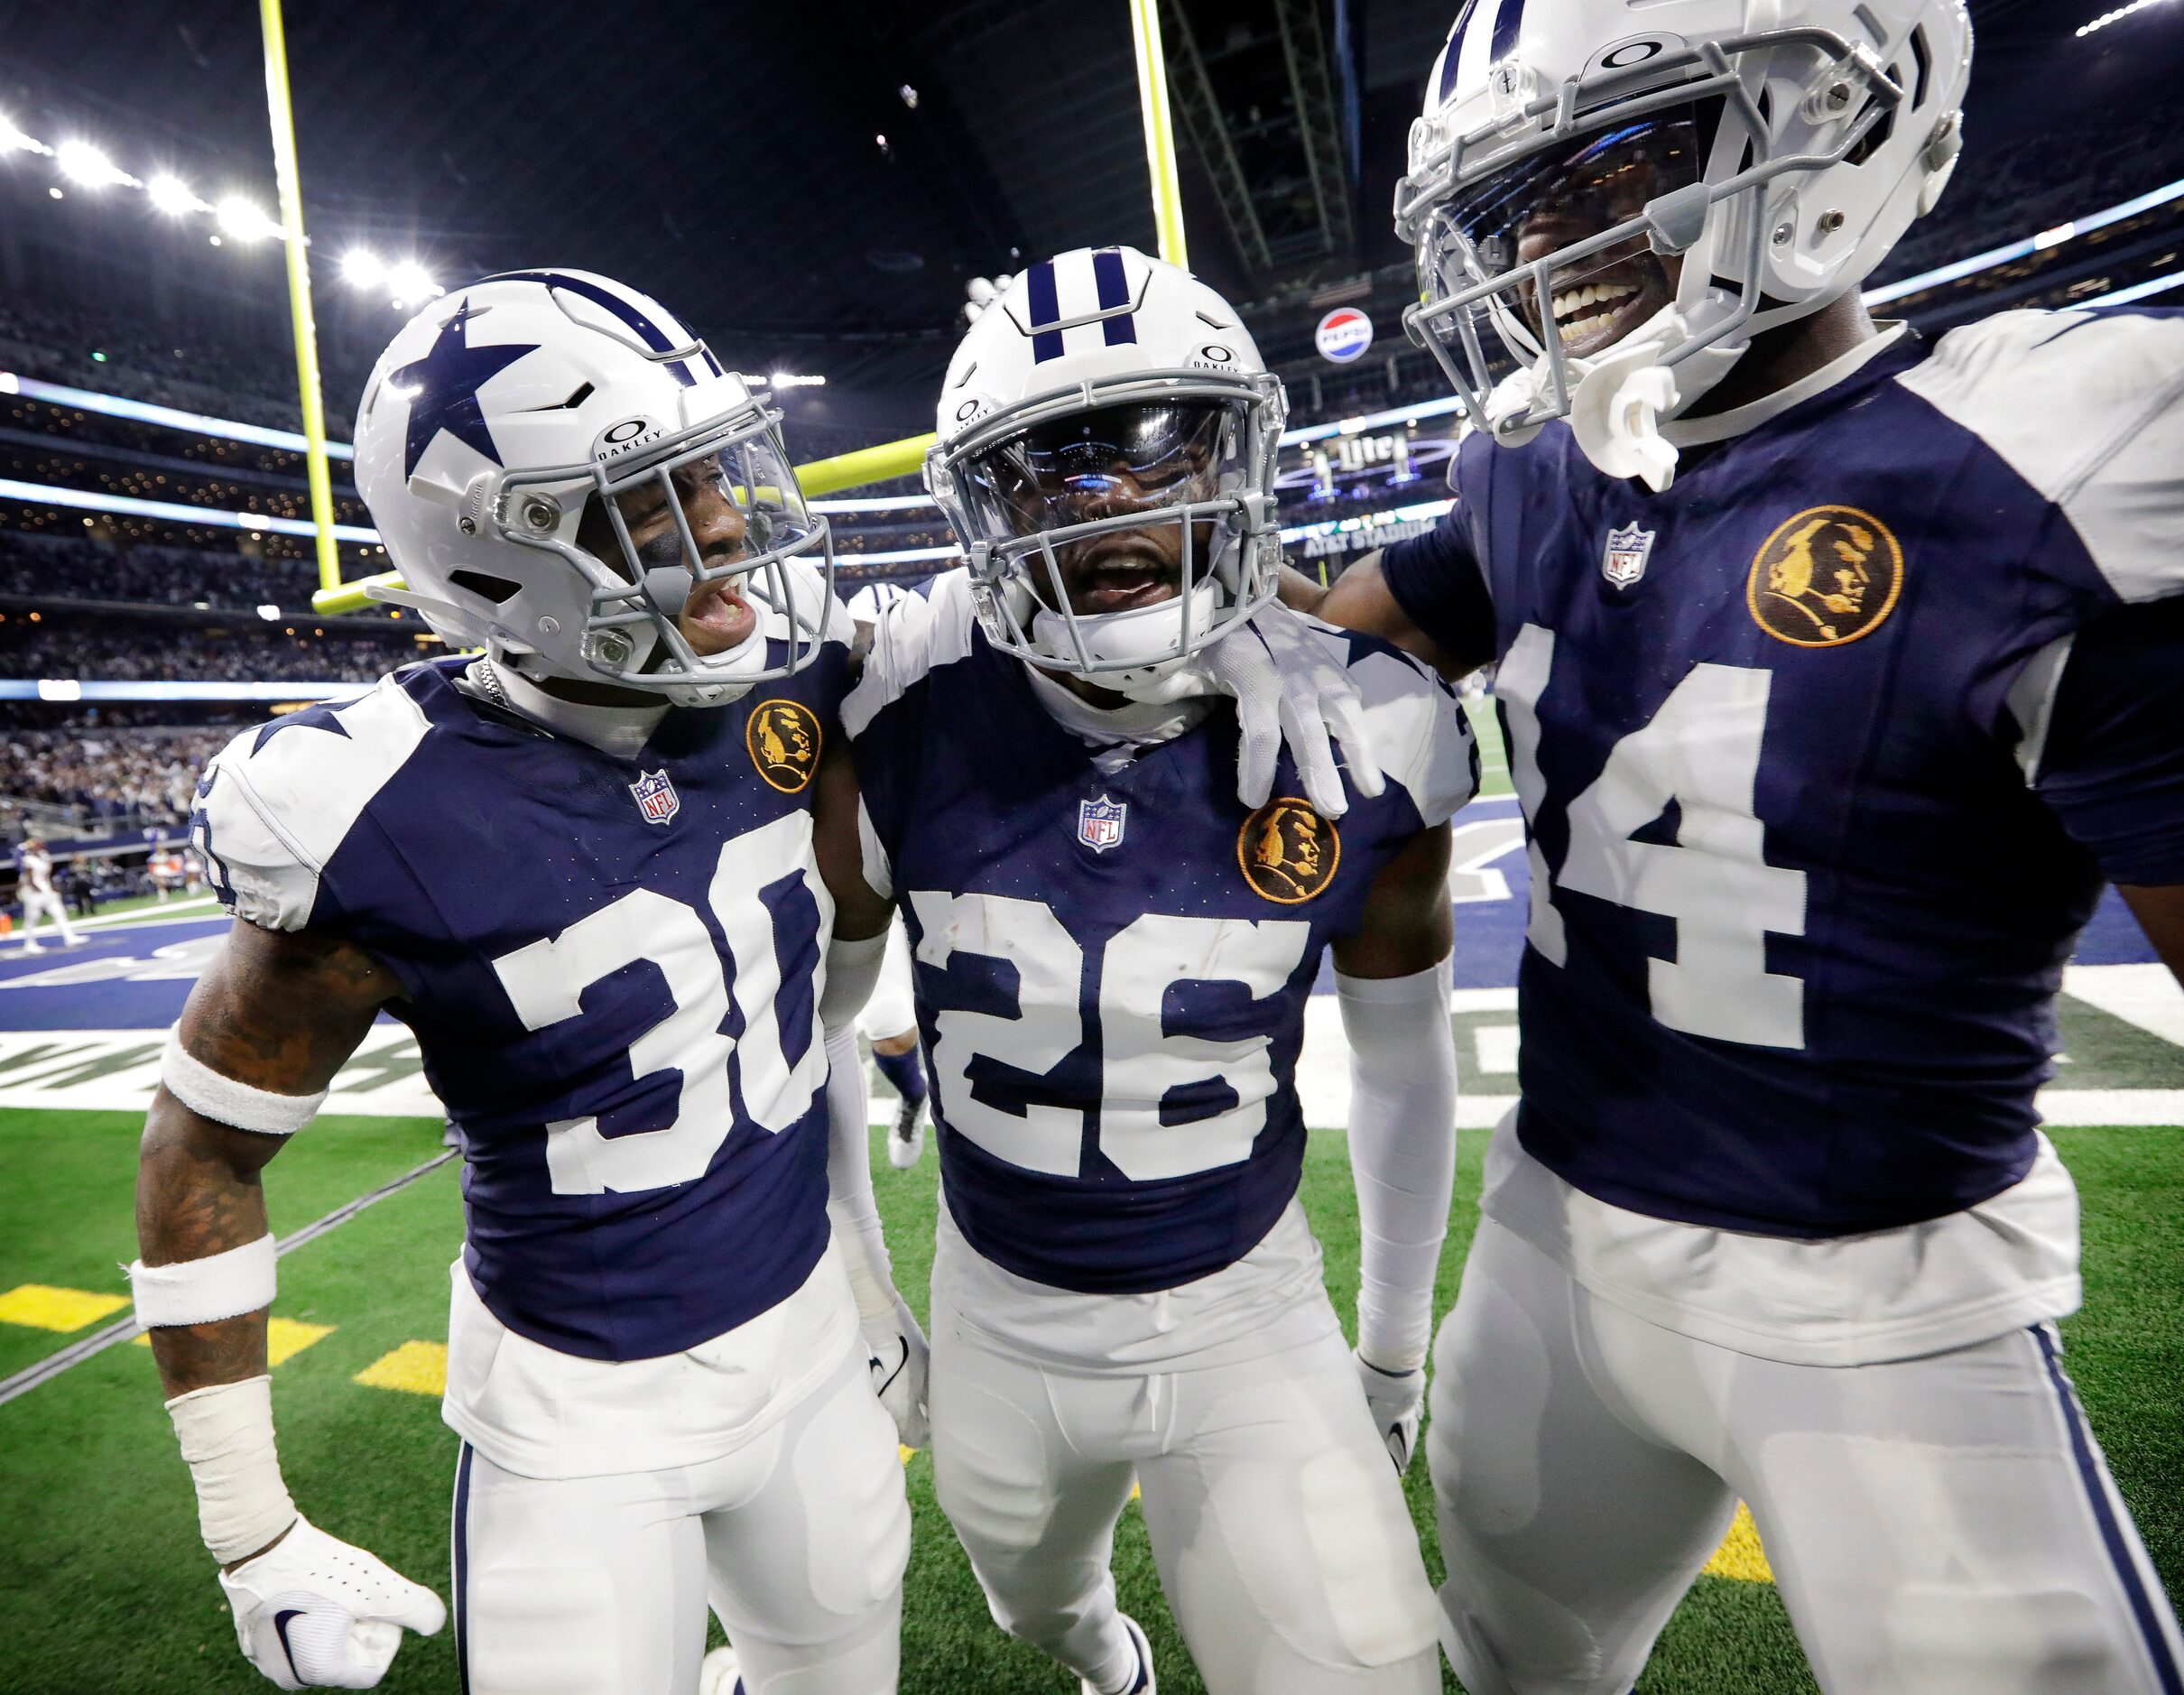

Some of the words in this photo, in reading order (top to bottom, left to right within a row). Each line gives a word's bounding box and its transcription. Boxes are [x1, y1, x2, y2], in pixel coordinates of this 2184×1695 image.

[597, 430, 661, 461] OAKLEY
[643, 779, 674, 817] NFL
[1086, 820, 1116, 843] NFL
[491, 809, 836, 1195] 30
[908, 891, 1311, 1182] 26
